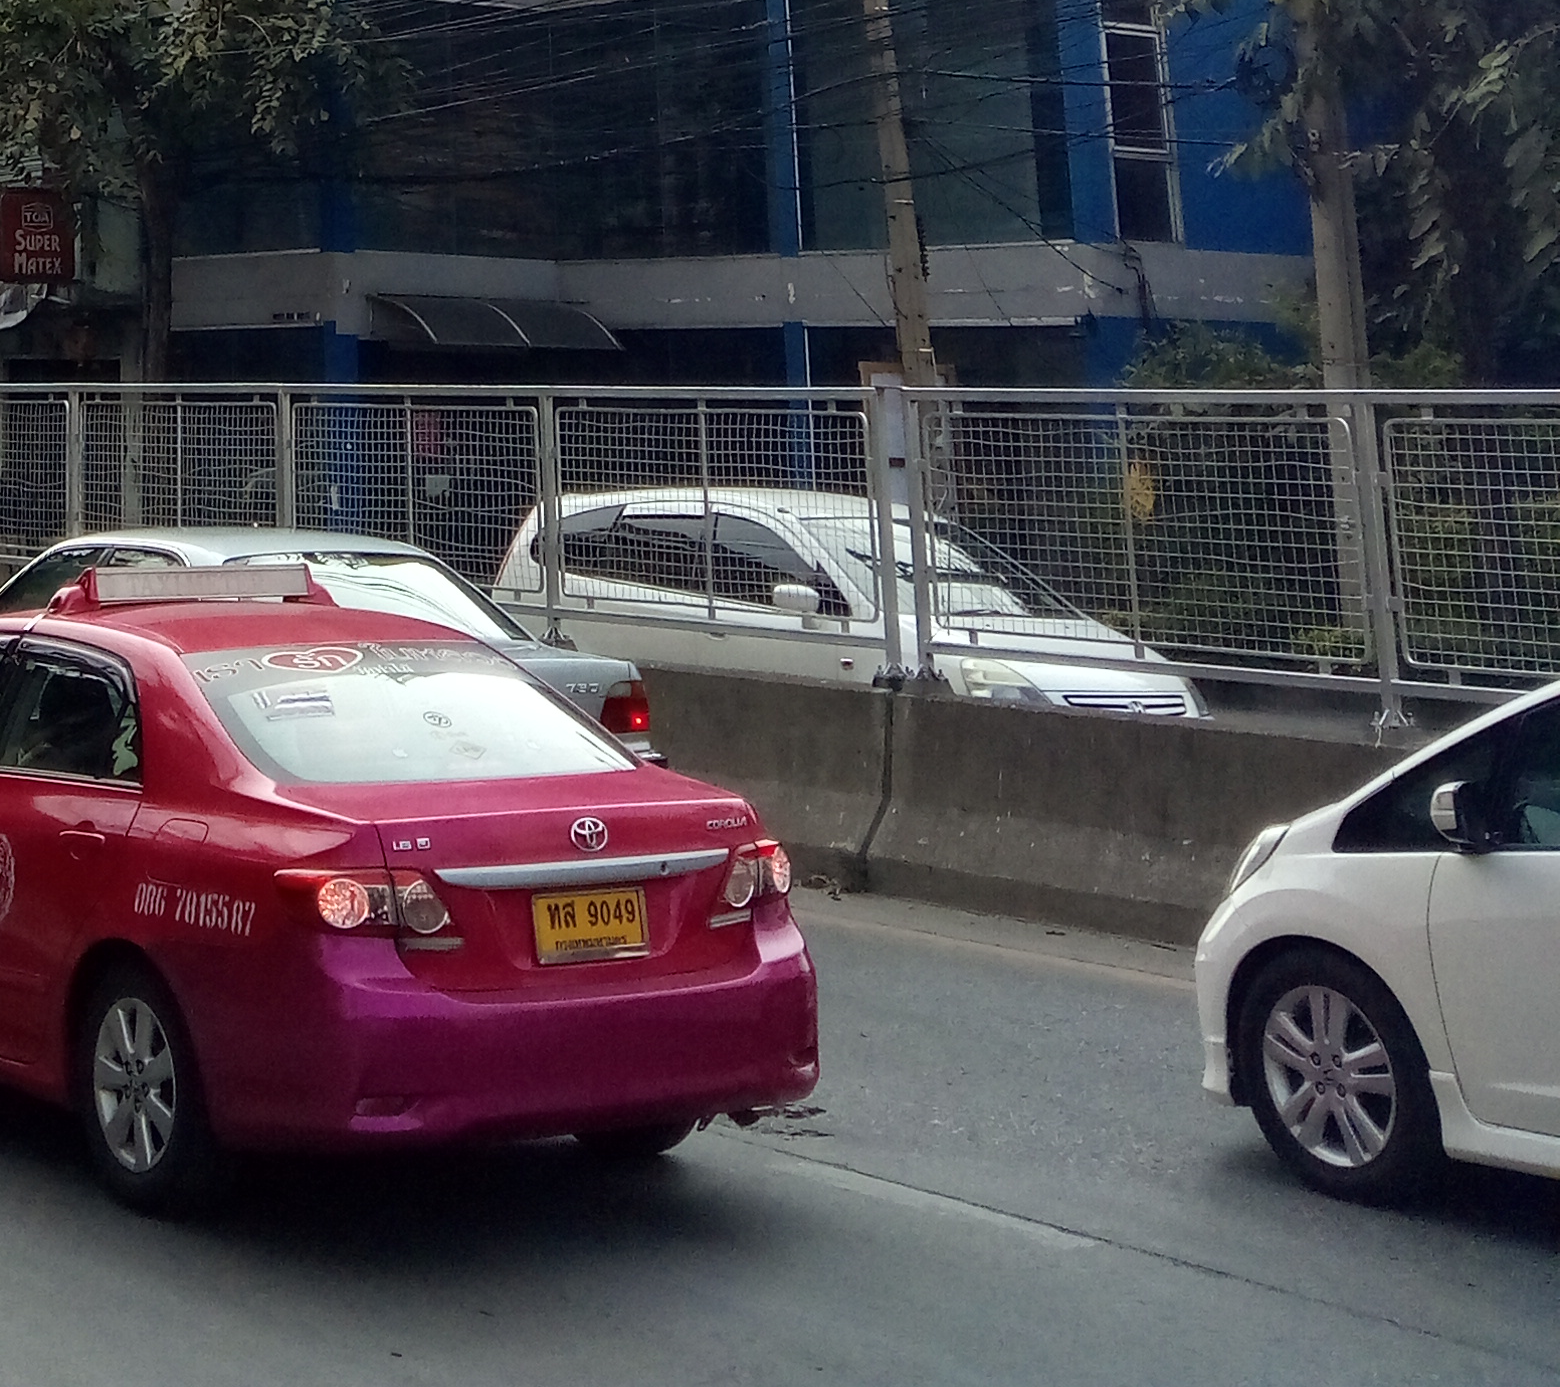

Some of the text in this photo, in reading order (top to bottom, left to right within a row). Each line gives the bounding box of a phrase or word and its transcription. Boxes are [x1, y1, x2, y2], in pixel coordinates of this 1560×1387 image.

[24, 212, 49, 222] TOA
[14, 229, 61, 252] SUPER
[14, 252, 61, 274] MATEX
[293, 653, 348, 669] รัก
[134, 882, 168, 916] 086
[587, 898, 637, 927] 9049
